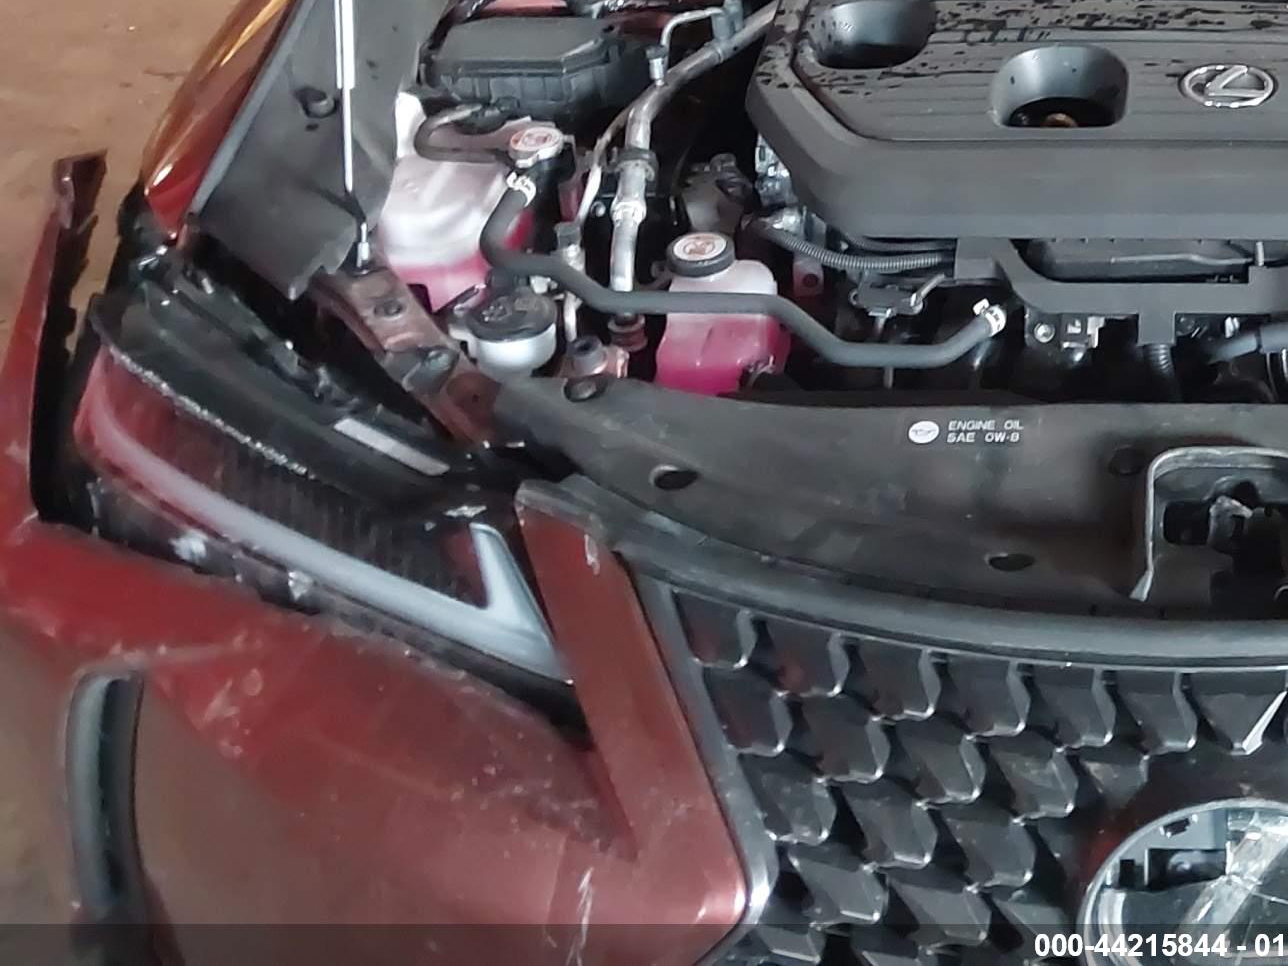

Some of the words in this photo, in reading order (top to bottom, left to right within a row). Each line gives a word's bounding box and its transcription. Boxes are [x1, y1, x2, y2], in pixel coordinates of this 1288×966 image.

[948, 420, 996, 431] ENGINE
[1004, 419, 1024, 430] OIL
[946, 432, 976, 443] SAE
